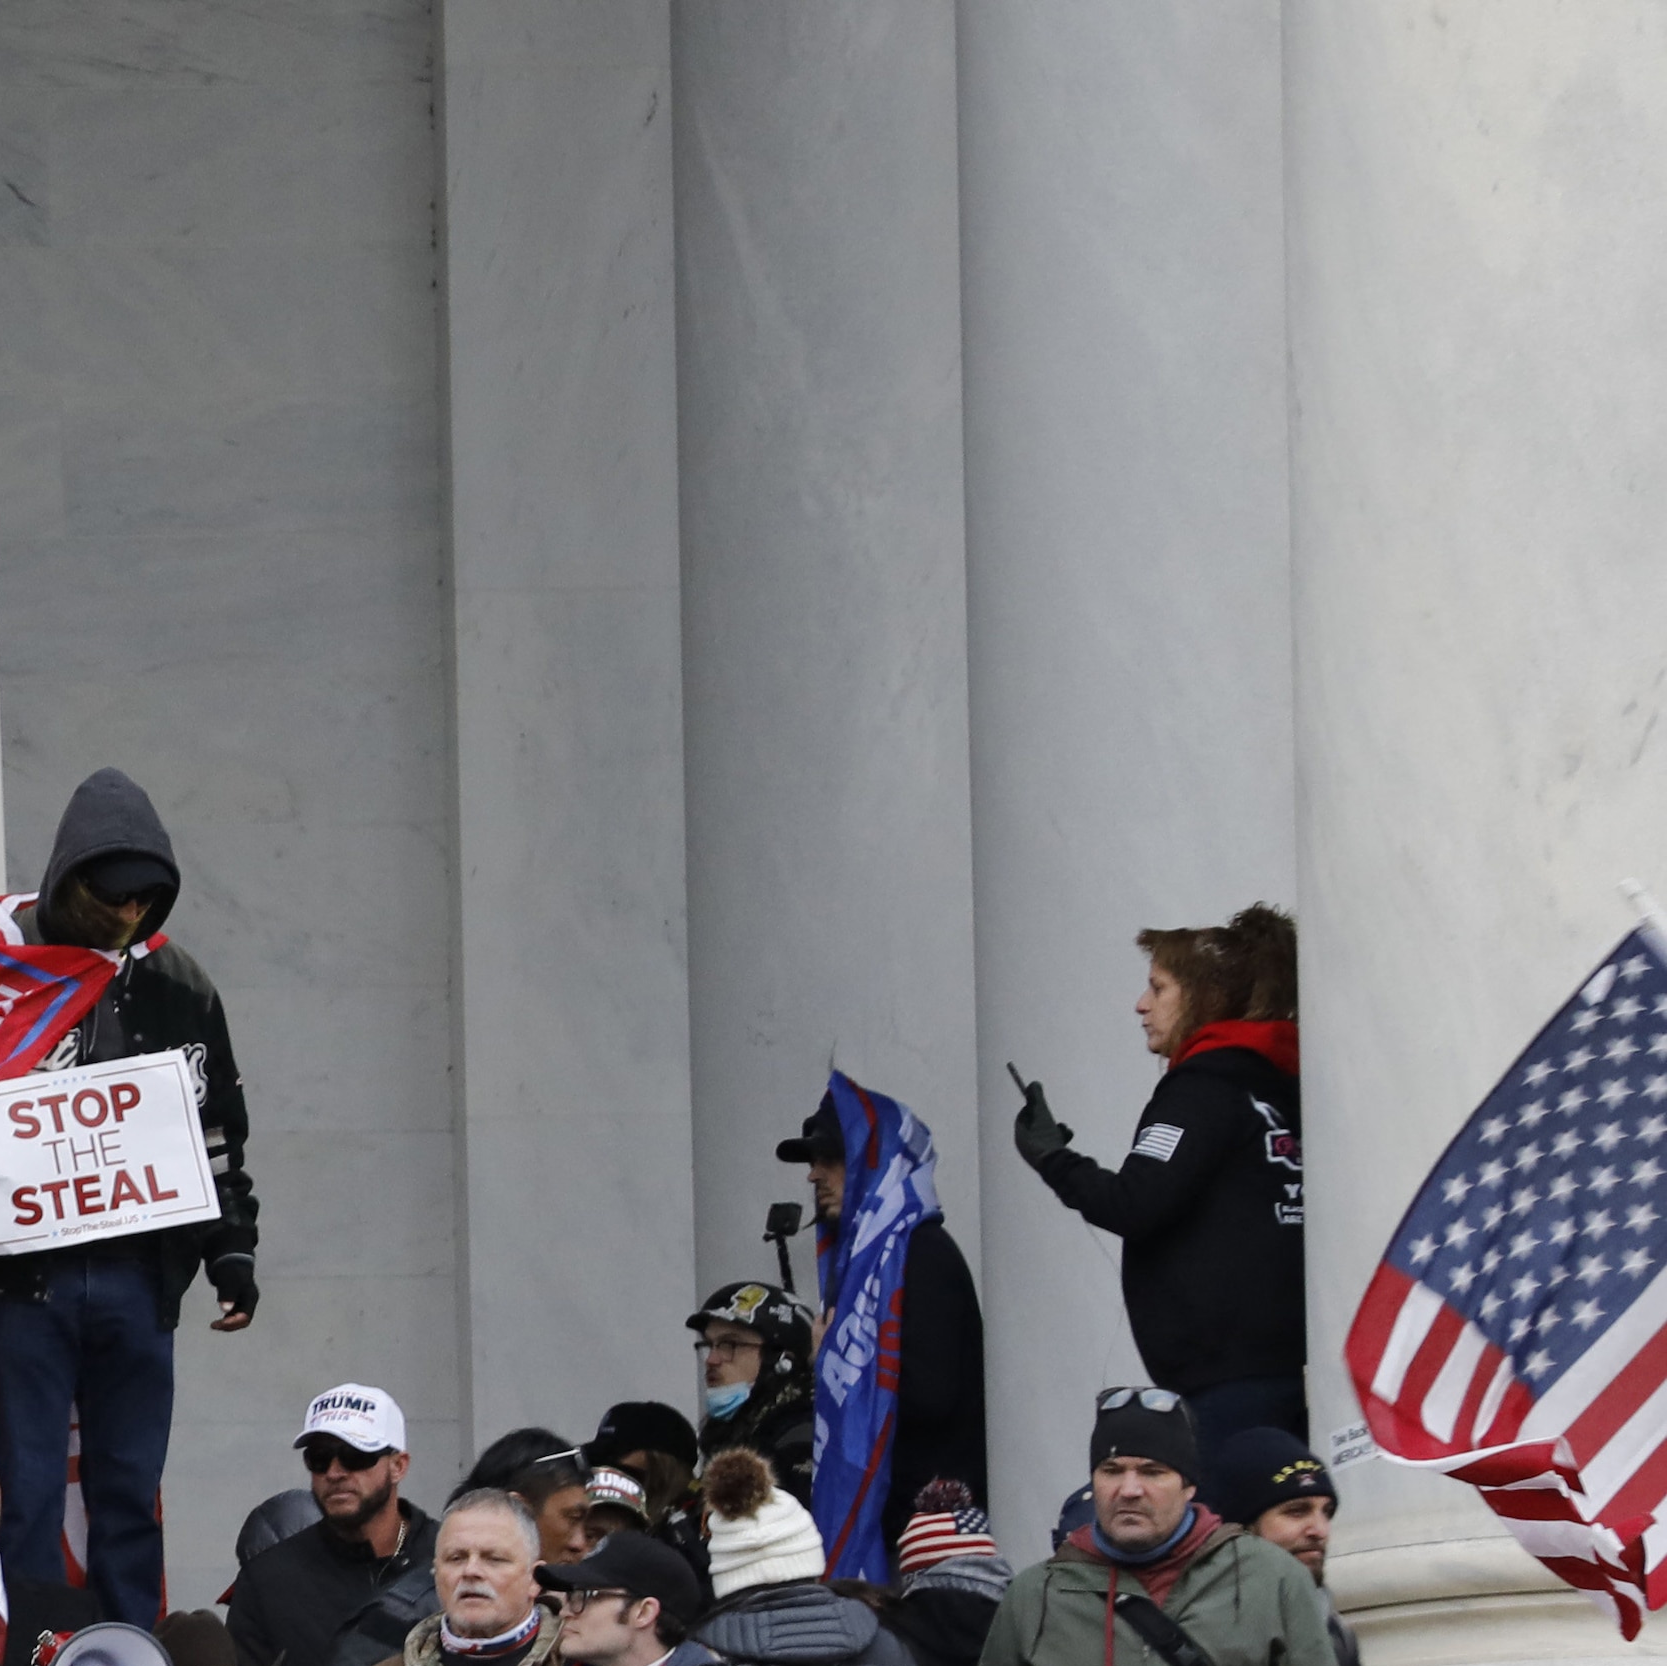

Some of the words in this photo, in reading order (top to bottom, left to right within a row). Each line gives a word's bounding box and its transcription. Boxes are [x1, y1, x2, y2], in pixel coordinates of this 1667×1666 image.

[7, 1082, 142, 1140] STOP
[41, 1129, 127, 1175] THE
[11, 1164, 180, 1227] STEAL
[312, 1395, 376, 1416] TRUMP
